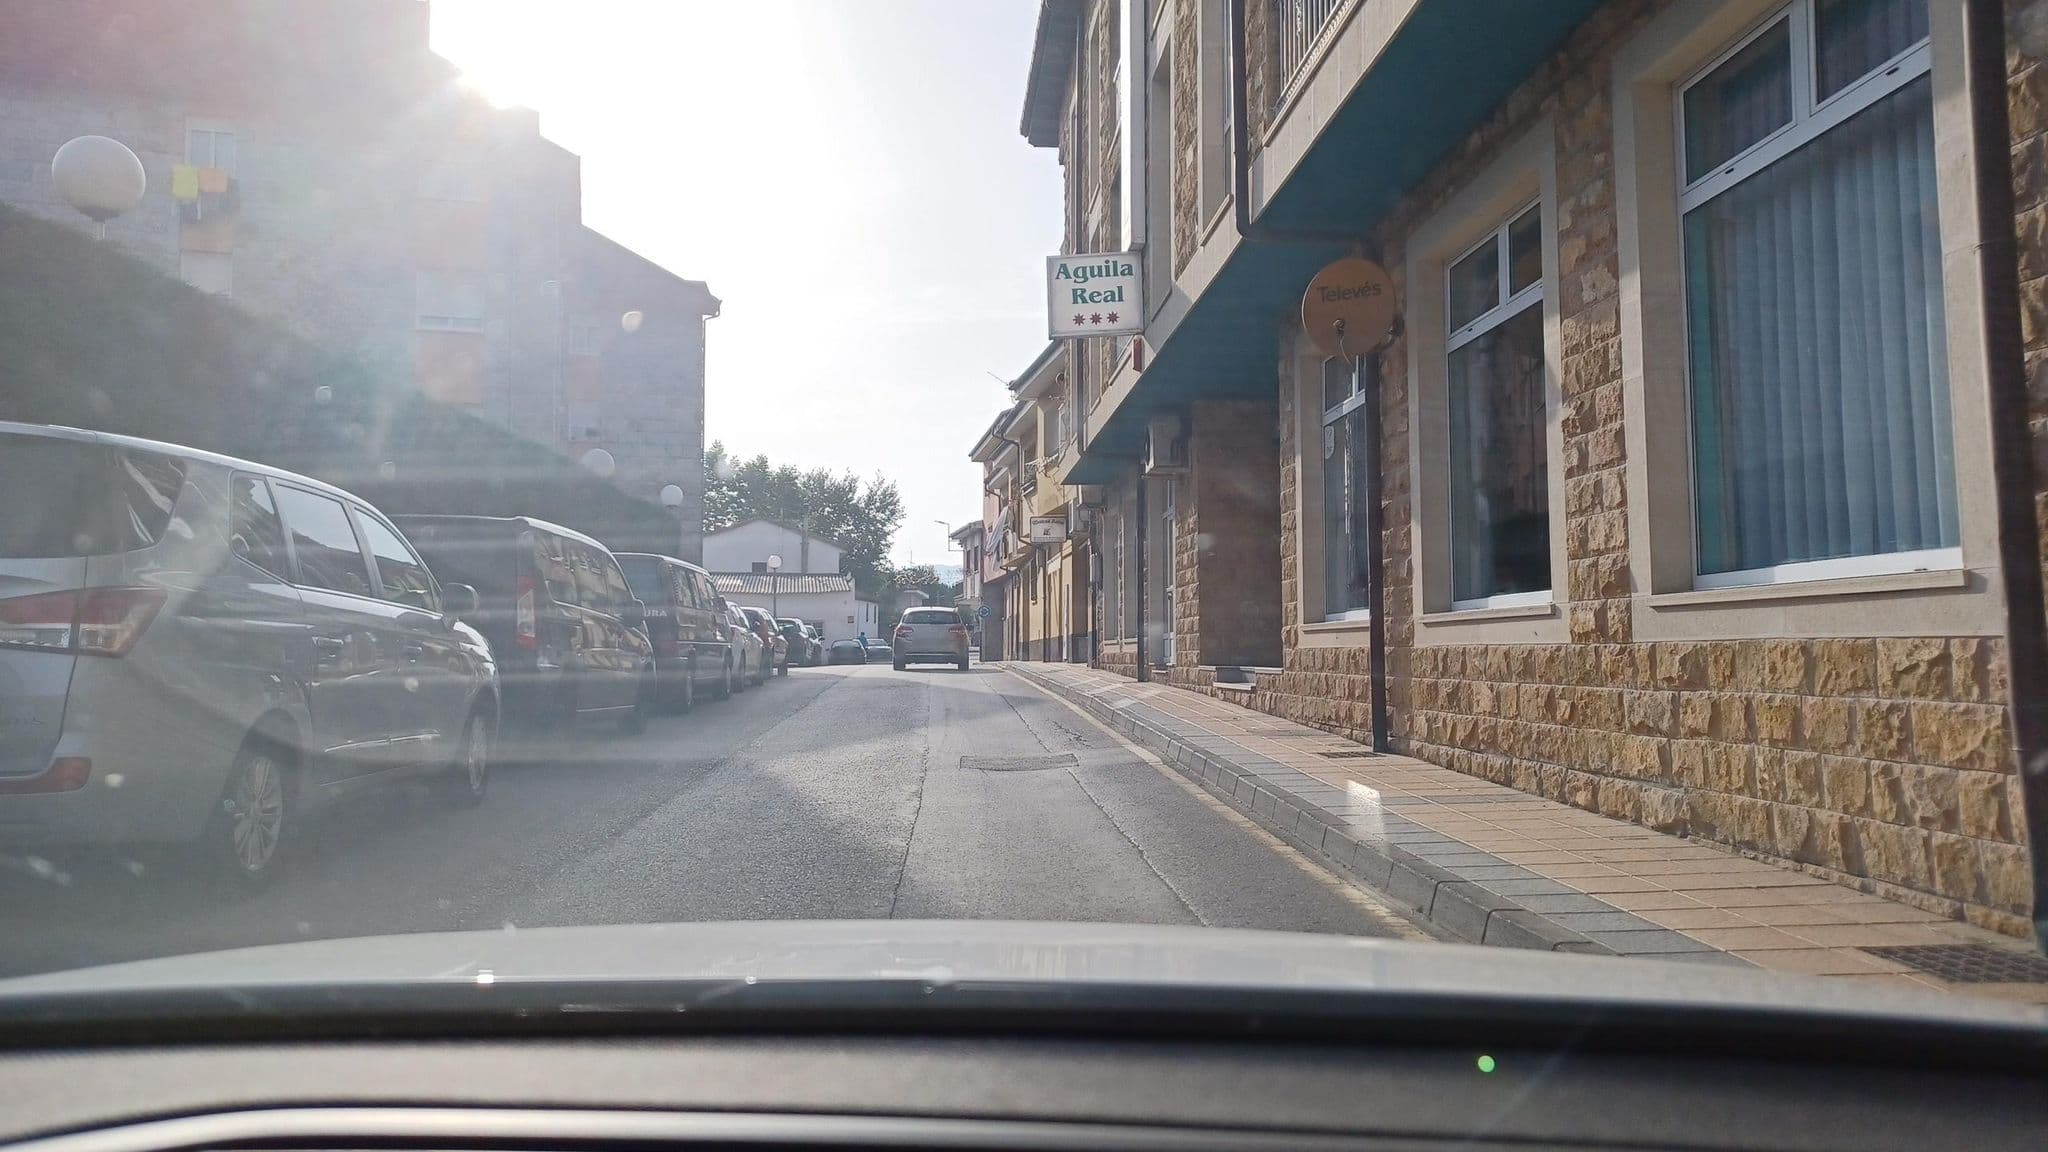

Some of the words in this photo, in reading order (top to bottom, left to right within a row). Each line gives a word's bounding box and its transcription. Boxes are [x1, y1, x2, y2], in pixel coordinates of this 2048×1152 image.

[1055, 259, 1134, 283] Aguila
[1071, 285, 1124, 305] Real
[1316, 281, 1382, 304] Televés
